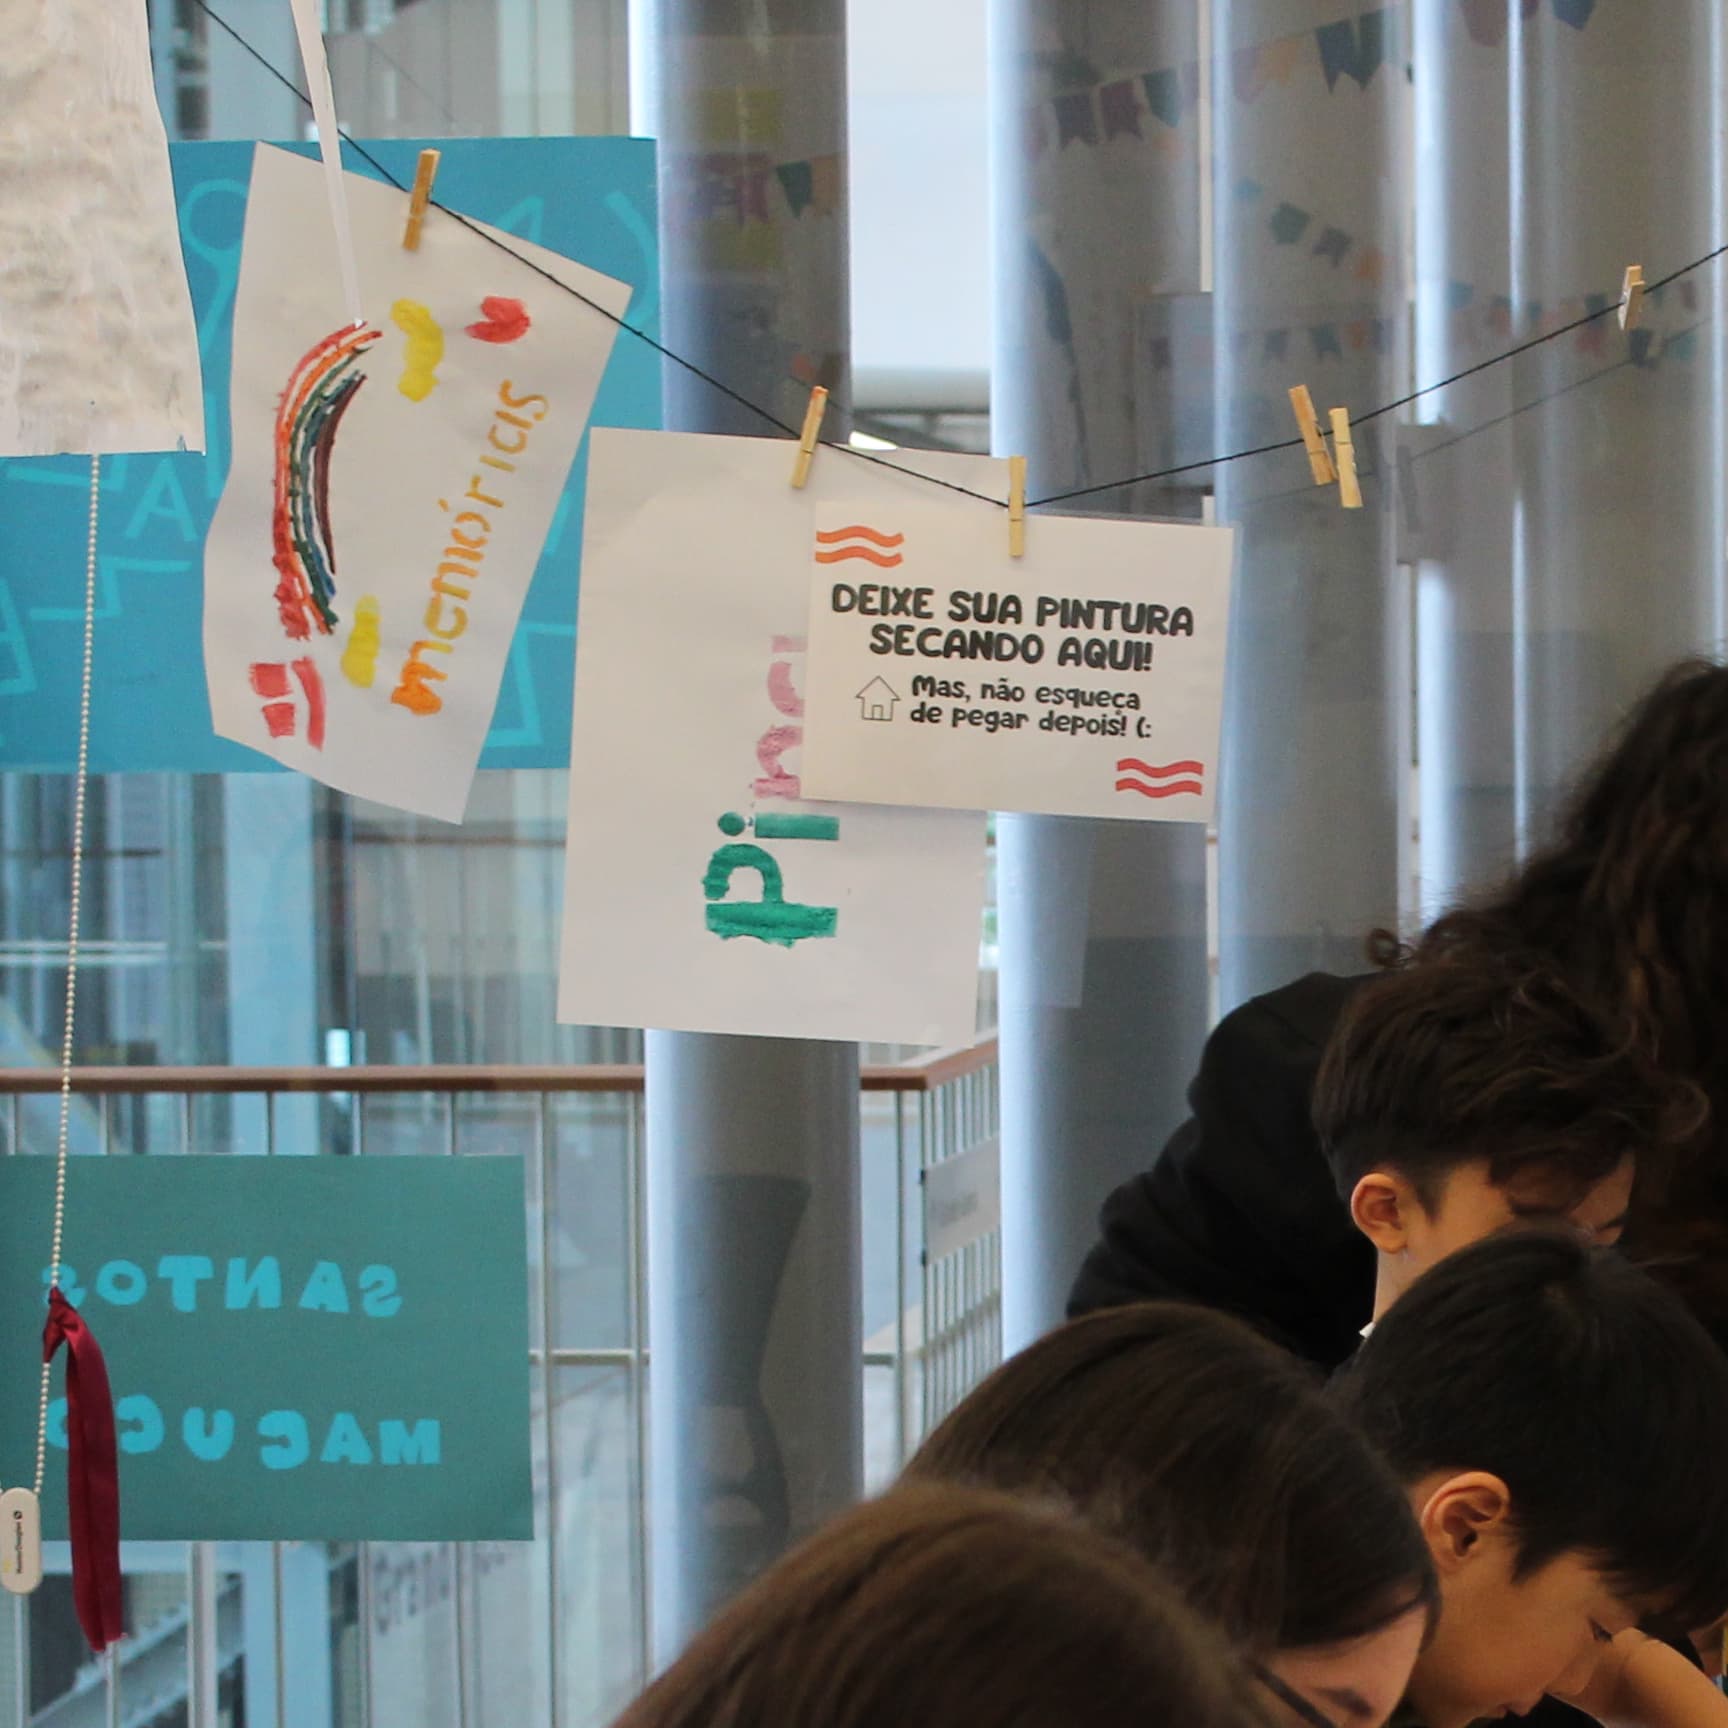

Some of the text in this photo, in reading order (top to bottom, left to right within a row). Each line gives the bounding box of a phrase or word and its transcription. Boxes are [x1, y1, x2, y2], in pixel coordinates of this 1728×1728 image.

[832, 583, 1194, 637] DEIXE SUA PINTURA
[869, 623, 1154, 672] SECANDO AQUI!
[911, 675, 1141, 715] Mas, não esqueça
[910, 702, 943, 724] de
[952, 705, 1029, 733] pegar
[1038, 711, 1127, 738] depois!
